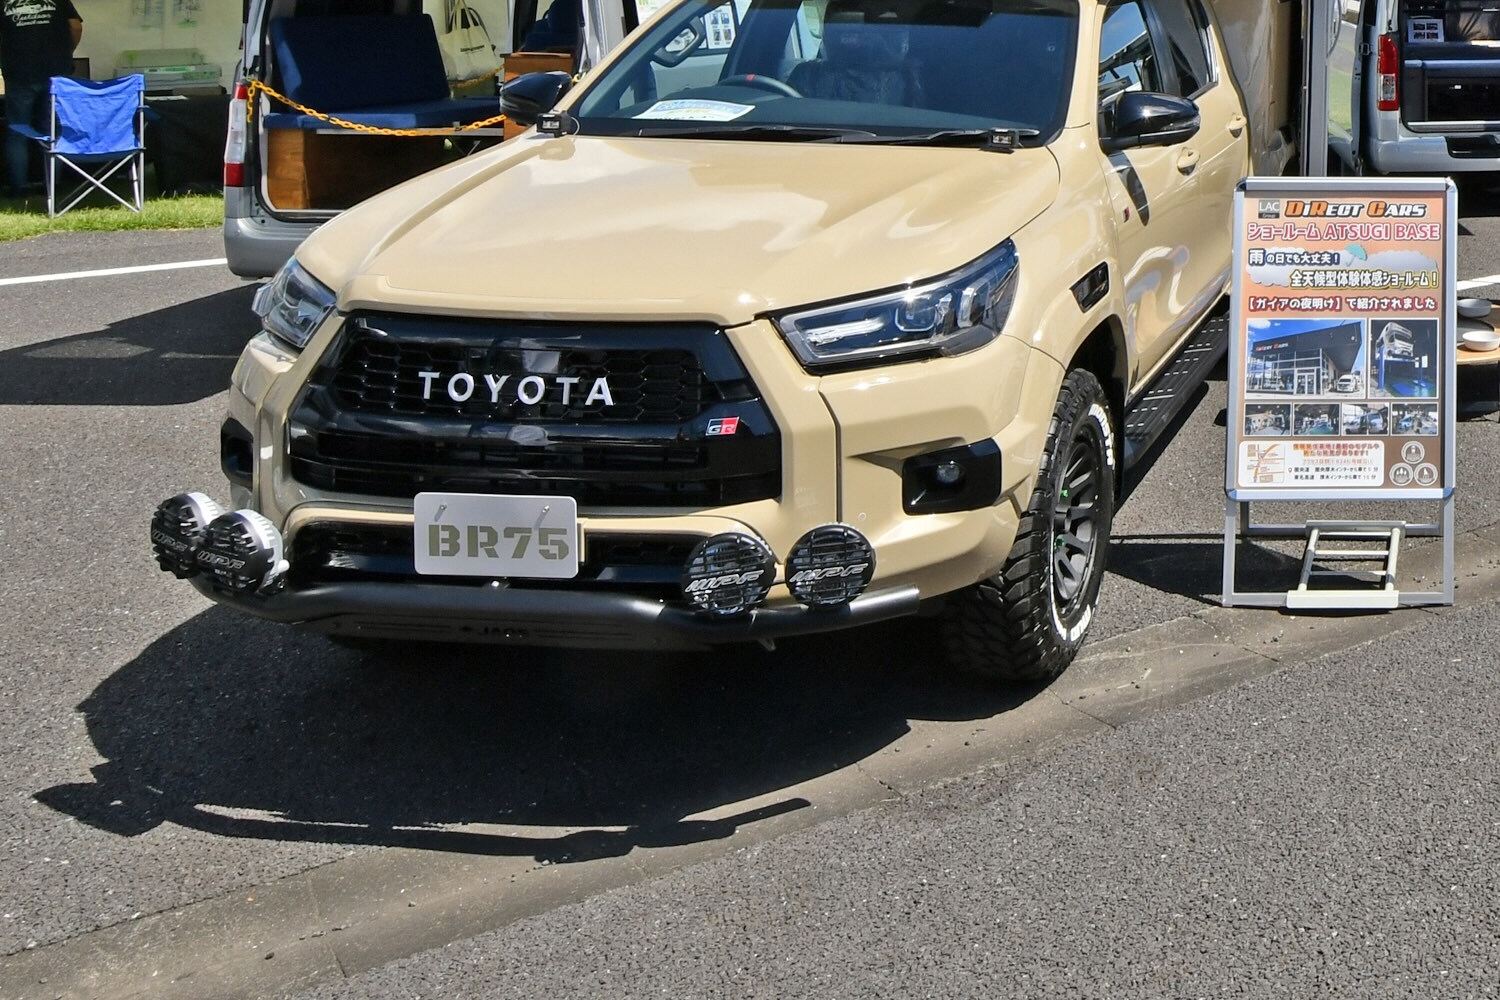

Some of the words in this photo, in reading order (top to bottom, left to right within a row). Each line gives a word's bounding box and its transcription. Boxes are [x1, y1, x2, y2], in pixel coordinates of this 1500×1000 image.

[1259, 201, 1280, 212] LAC
[1367, 201, 1427, 218] CARS
[1247, 223, 1320, 241] ショールーム
[1323, 223, 1391, 240] ATSUGI
[1394, 223, 1440, 240] BASE
[1248, 249, 1340, 265] 雨の日でも大丈夫！
[418, 371, 614, 406] TOYOTA
[707, 419, 738, 435] GR
[428, 524, 569, 561] BR75
